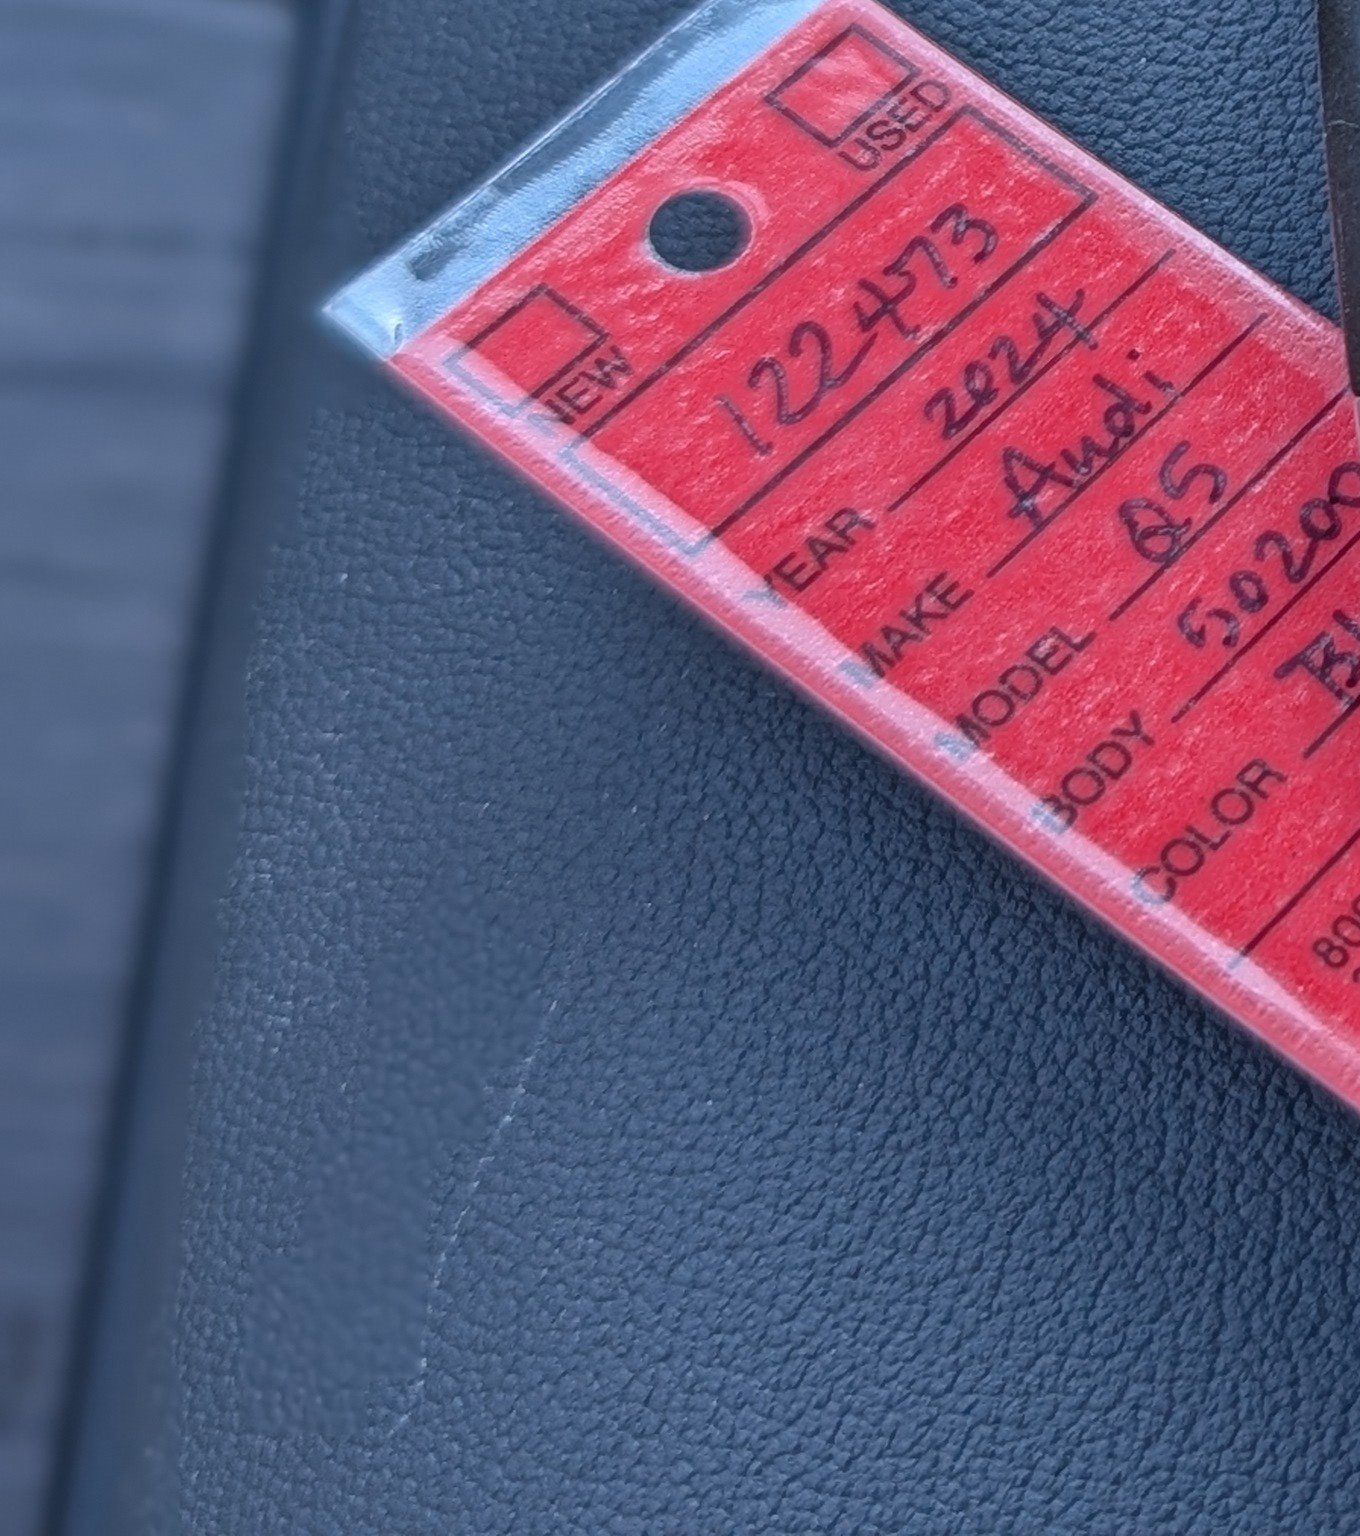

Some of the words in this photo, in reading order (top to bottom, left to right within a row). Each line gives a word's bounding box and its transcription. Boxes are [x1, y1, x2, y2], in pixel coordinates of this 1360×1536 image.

[838, 80, 954, 172] USED
[526, 344, 635, 438] NEW
[716, 202, 999, 457] 122473
[924, 288, 1099, 440] 2024
[742, 506, 877, 610] YEAR
[838, 571, 975, 690] MAKE
[933, 626, 1096, 762] MODEL
[1030, 709, 1155, 836] BODY
[1129, 757, 1288, 906] COLOR
